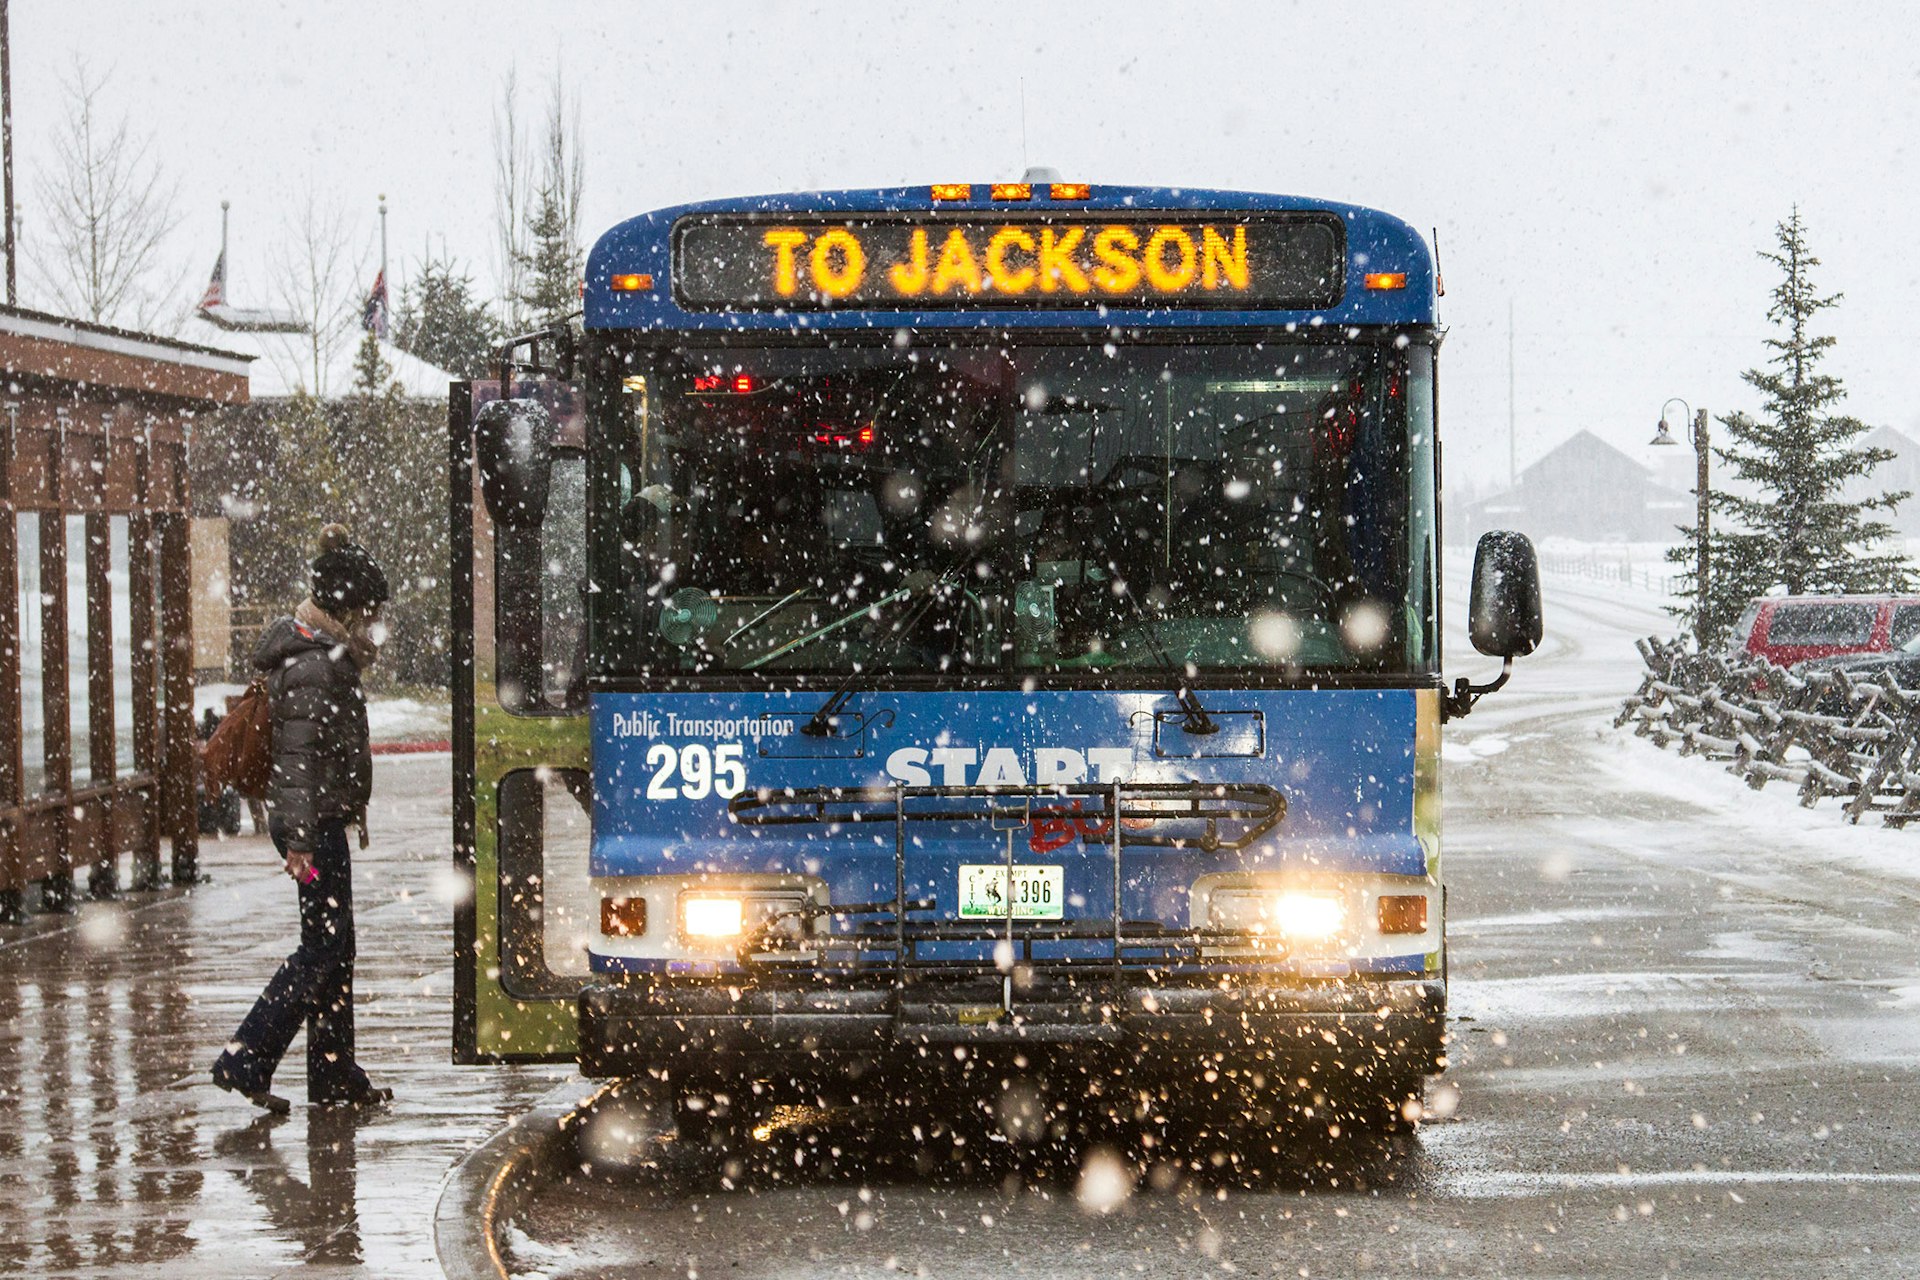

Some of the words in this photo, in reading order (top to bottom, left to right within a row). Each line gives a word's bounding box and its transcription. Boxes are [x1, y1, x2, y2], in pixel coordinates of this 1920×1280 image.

[763, 227, 866, 297] TO
[890, 226, 1250, 294] JACKSON
[613, 711, 661, 737] Public
[667, 712, 794, 741] Transportation
[646, 743, 746, 800] 295
[886, 747, 1133, 799] START
[995, 869, 1027, 878] EXMPT
